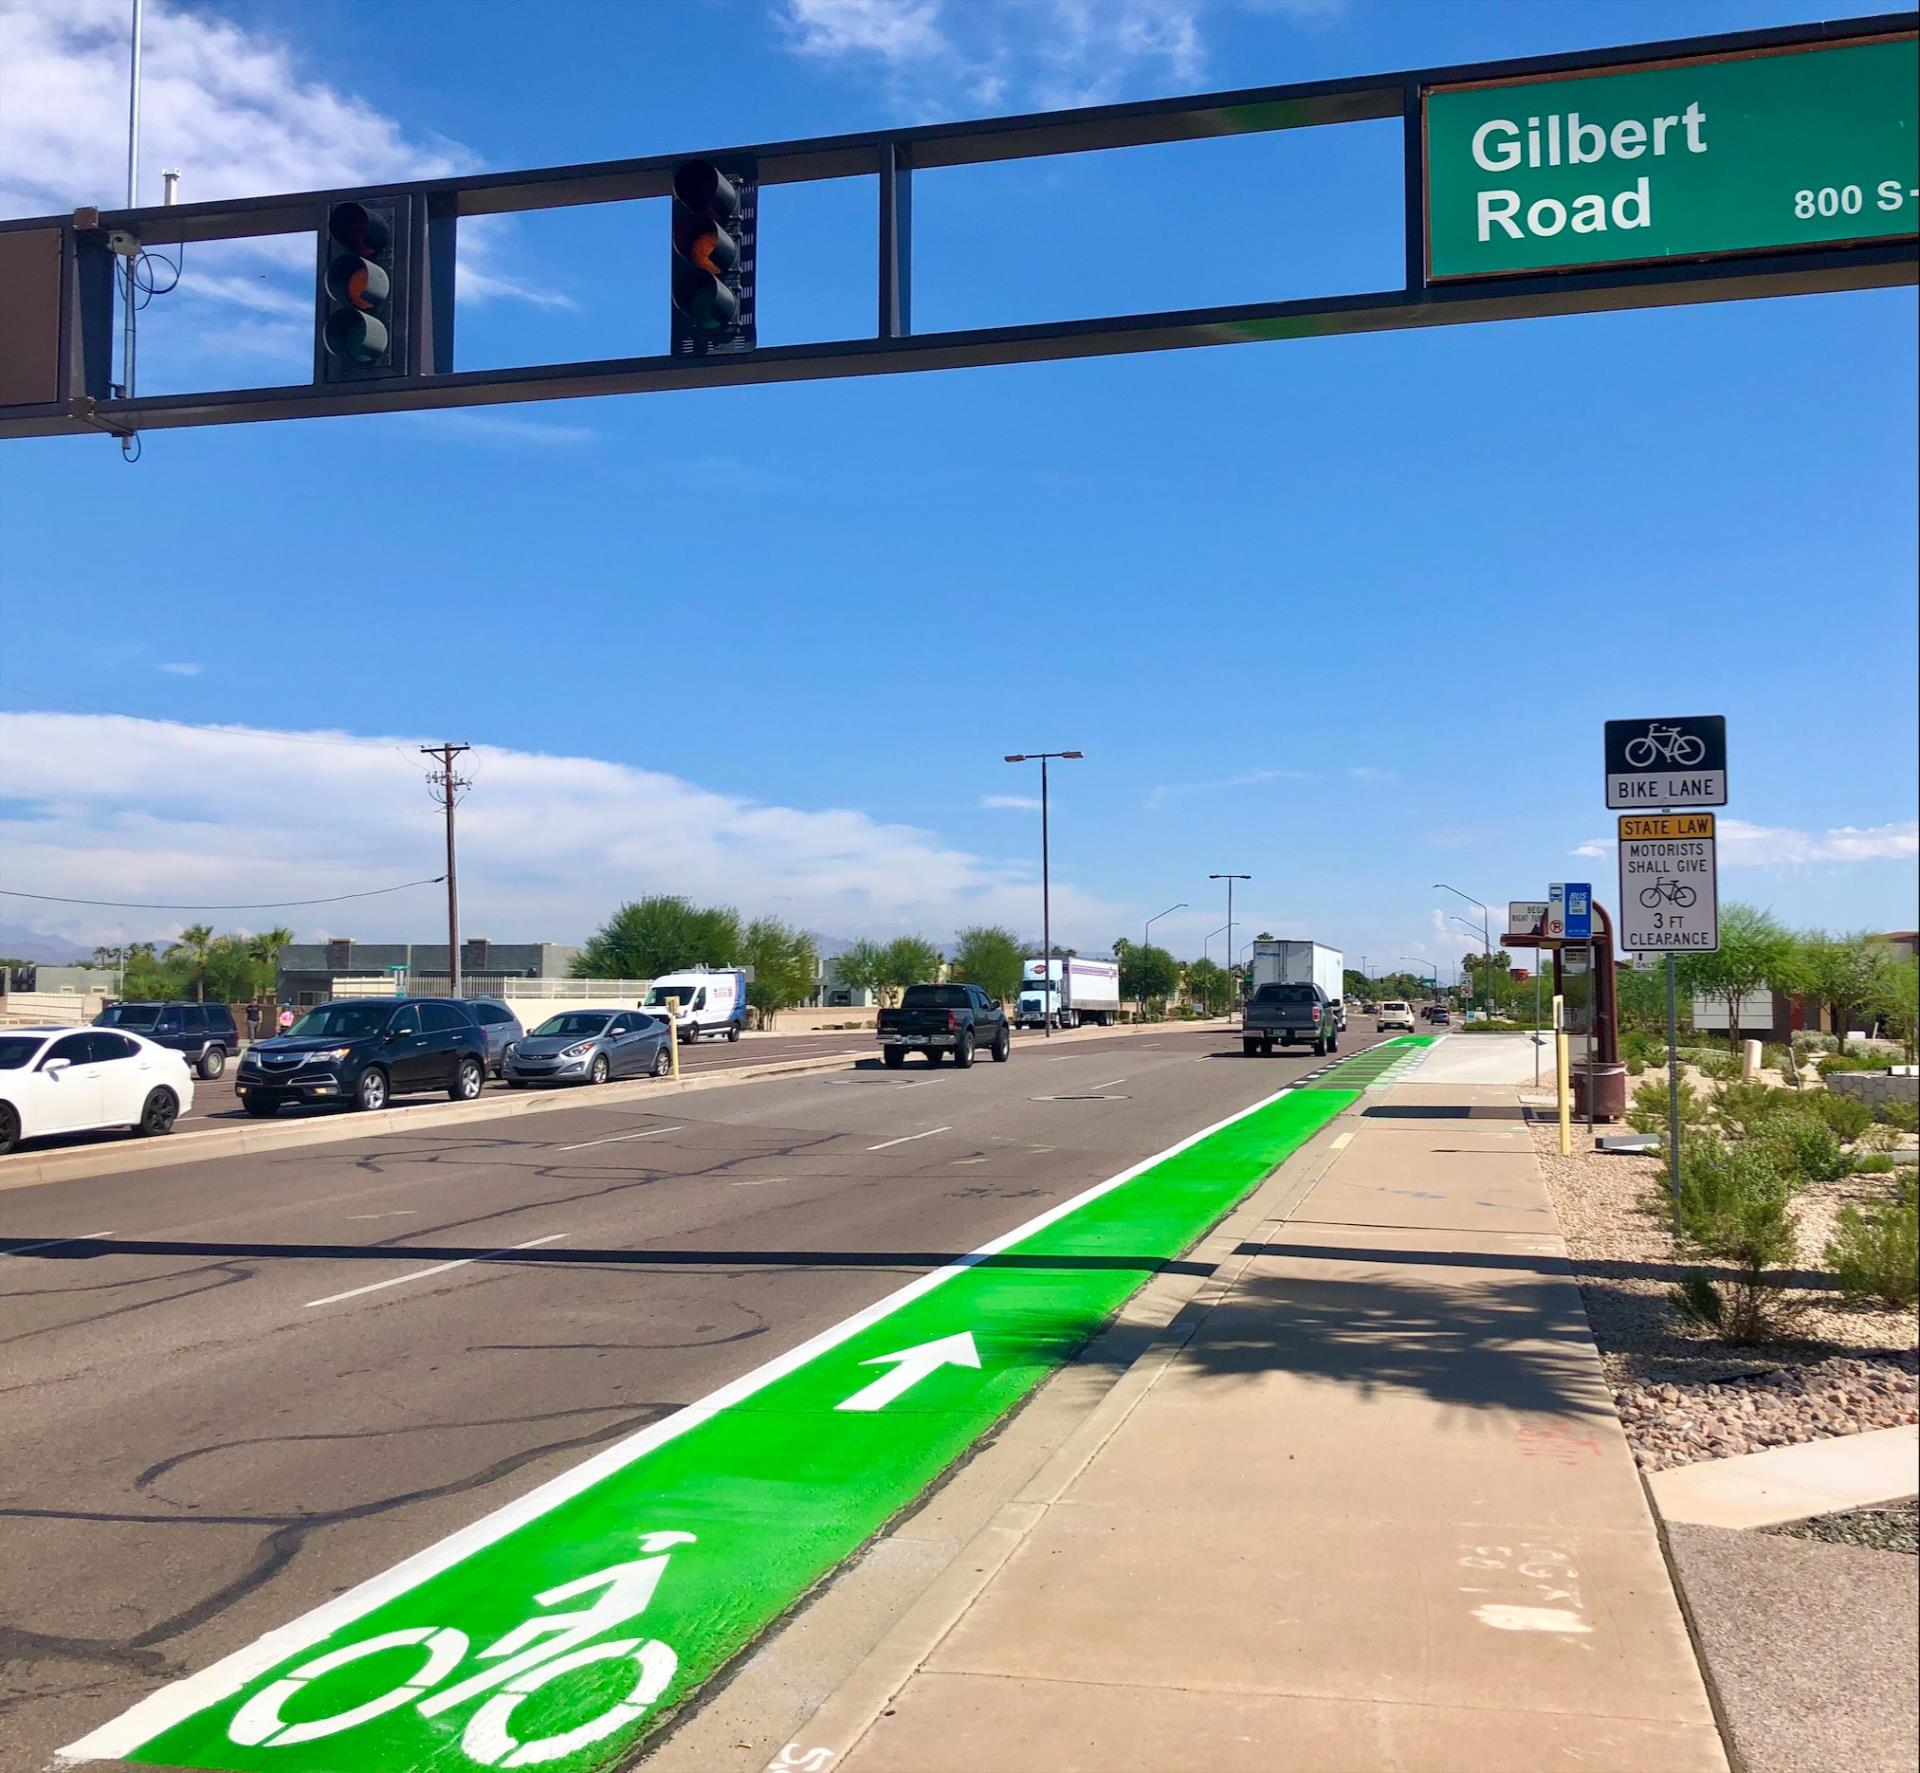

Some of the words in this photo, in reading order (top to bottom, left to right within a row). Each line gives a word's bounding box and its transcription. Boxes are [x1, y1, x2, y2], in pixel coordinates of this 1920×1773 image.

[1471, 101, 1707, 172] Gilbert
[1477, 177, 1651, 242] Road
[1794, 184, 1863, 219] 800
[1618, 781, 1659, 799] BIKE
[1669, 778, 1714, 797] LANE
[1624, 821, 1670, 836] STATE
[1677, 818, 1709, 835] LAW
[1630, 843, 1704, 858] MOTORISTS
[1628, 861, 1671, 874] SHALL
[1677, 859, 1708, 873] GIVE
[1569, 892, 1587, 900] BUS
[1653, 913, 1664, 930] 3
[1670, 916, 1684, 929] FT
[1630, 932, 1710, 946] CLEARANCE
